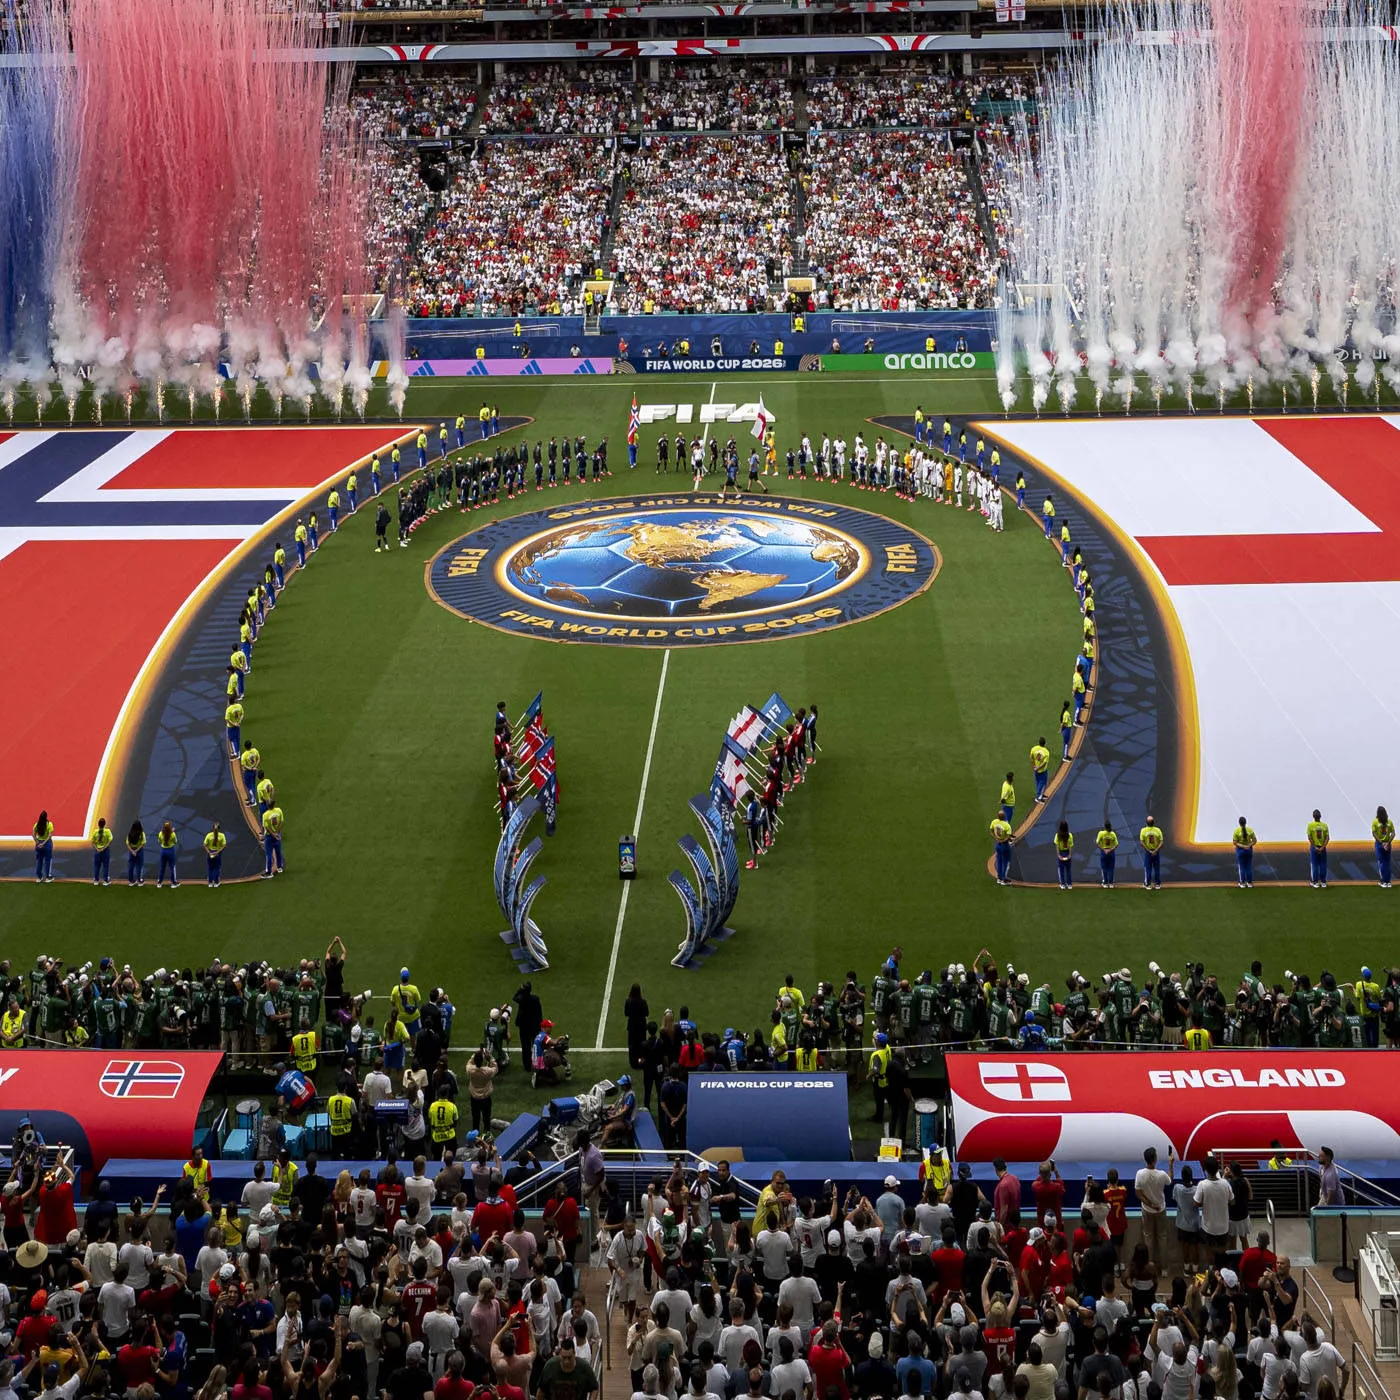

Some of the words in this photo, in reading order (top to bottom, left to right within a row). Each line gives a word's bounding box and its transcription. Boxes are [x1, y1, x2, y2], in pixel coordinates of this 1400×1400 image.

[646, 361, 671, 370] FIFA
[673, 360, 715, 370] WORLD
[717, 359, 740, 369] CUP
[741, 358, 783, 368] 2026
[884, 351, 976, 369] aramco
[639, 403, 776, 424] FIFA
[548, 502, 635, 520] 2026
[692, 498, 782, 510] WORLD
[787, 504, 838, 518] FIFA
[447, 548, 489, 577] FIFA
[886, 543, 918, 572] FIFA
[499, 609, 553, 630] FIFA
[555, 620, 667, 639] WORLD
[675, 623, 736, 638] CUP
[741, 606, 843, 634] 2026
[701, 1081, 725, 1089] FIFA
[1149, 1068, 1347, 1088] ENGLAND
[1111, 1202, 1122, 1218] 7
[55, 1301, 76, 1320] 10
[414, 1297, 424, 1317] 7
